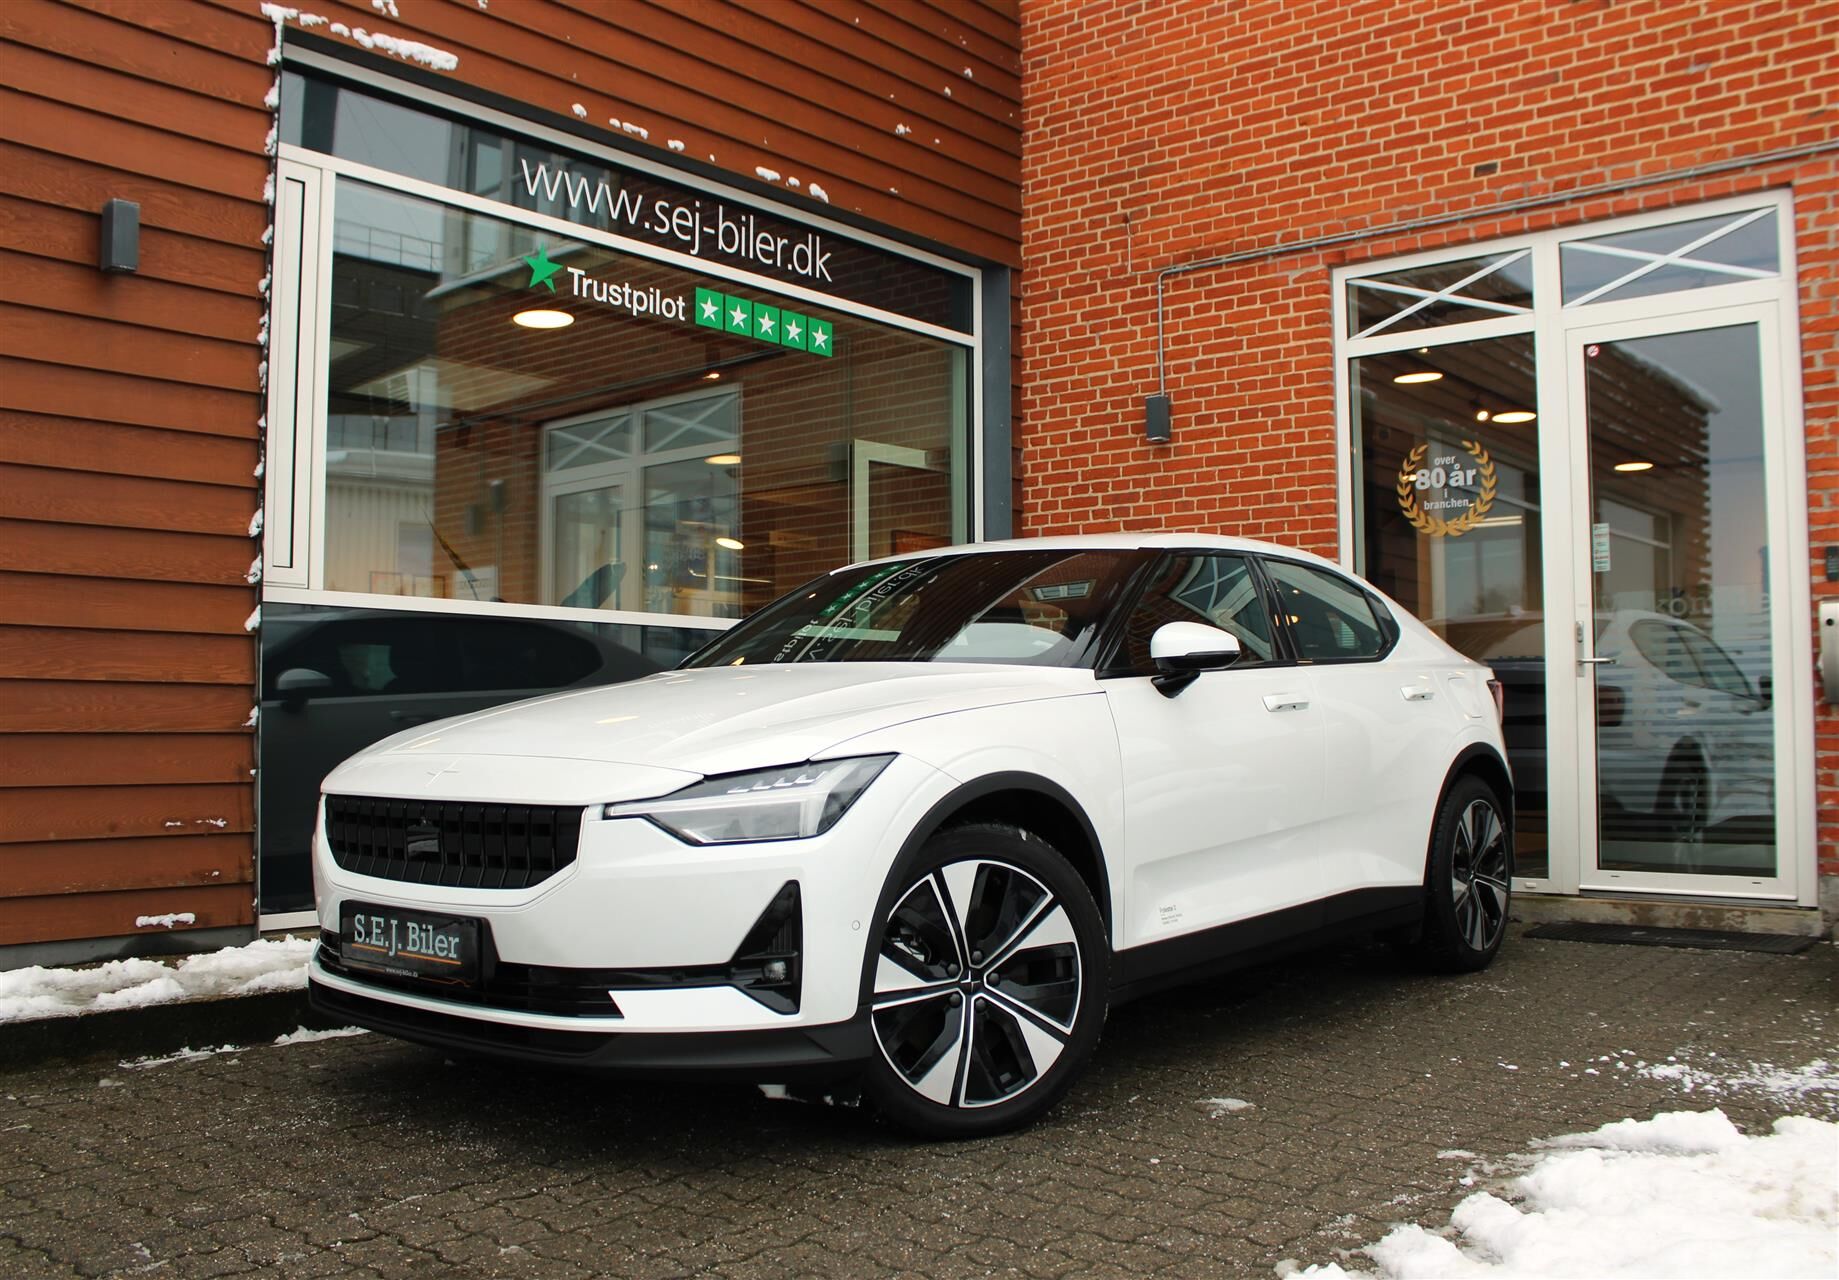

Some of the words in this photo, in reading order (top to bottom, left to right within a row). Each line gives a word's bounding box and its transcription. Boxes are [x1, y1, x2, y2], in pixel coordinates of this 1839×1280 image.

[521, 158, 833, 282] www.sej-biler.dk
[567, 266, 686, 321] Trustpilot
[1415, 467, 1446, 490] 80
[1449, 463, 1477, 487] år
[1434, 455, 1456, 466] over
[1424, 498, 1469, 511] branchen
[354, 913, 402, 956] S.E.J.
[406, 921, 460, 958] Biler
